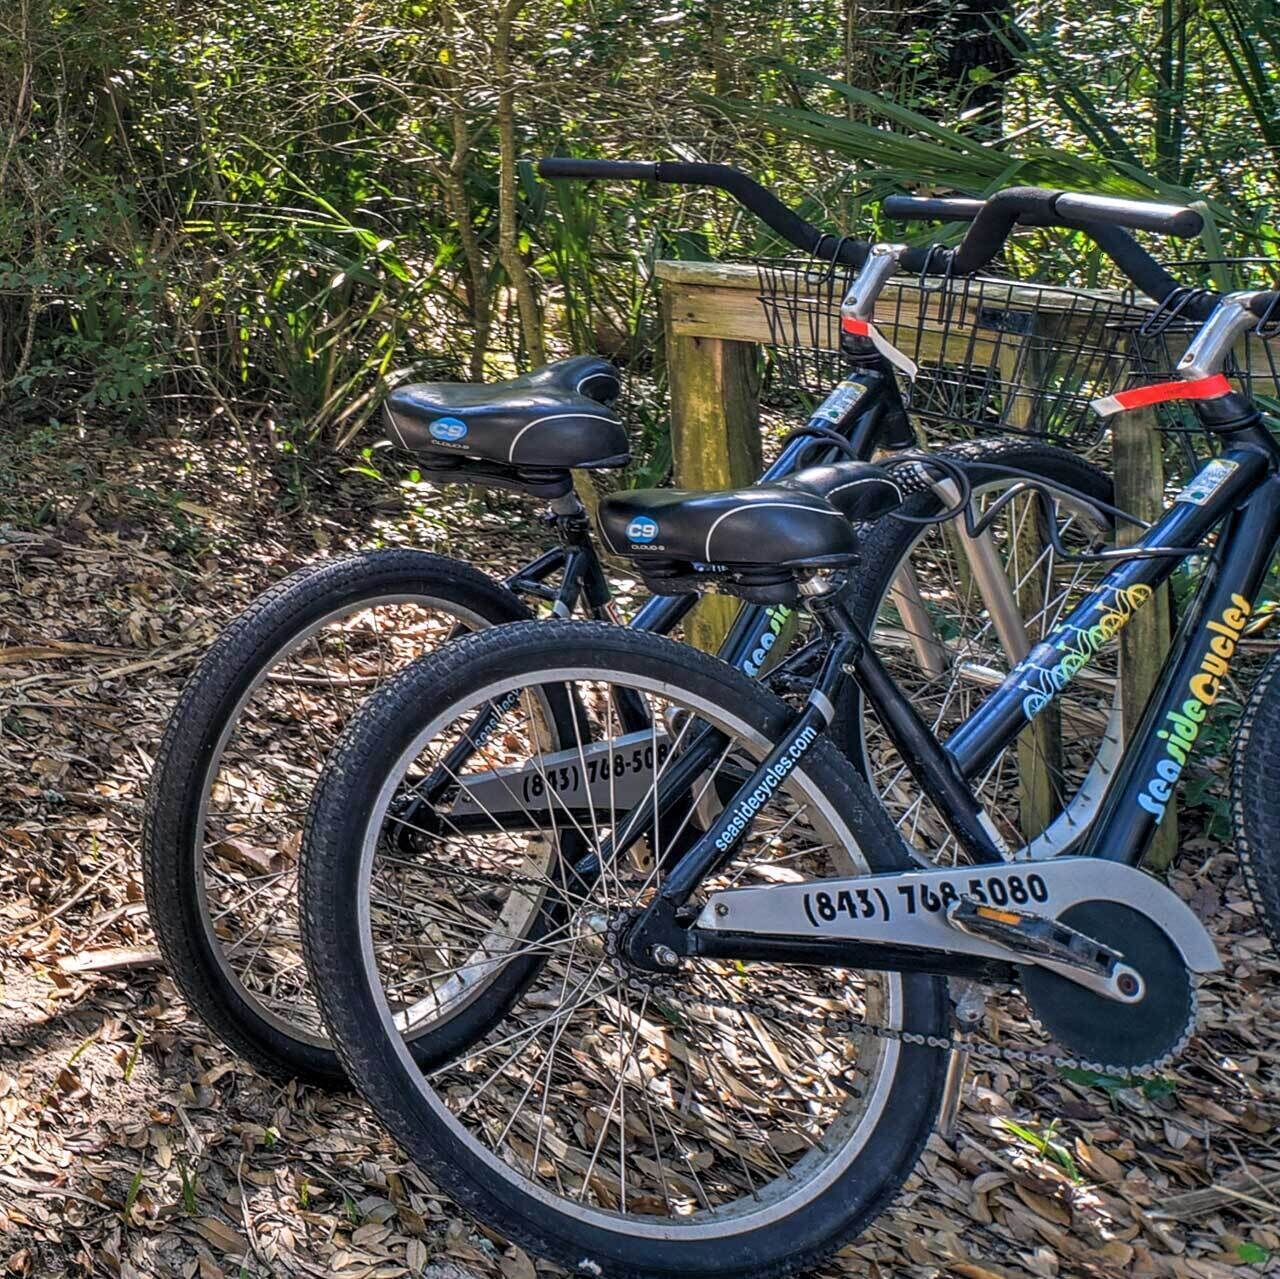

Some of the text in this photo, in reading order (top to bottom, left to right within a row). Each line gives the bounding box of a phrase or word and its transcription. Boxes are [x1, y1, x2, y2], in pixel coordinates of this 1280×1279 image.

[431, 423, 463, 437] C9
[628, 523, 656, 537] C9
[715, 725, 817, 852] seasidecycles.com
[803, 888, 890, 927] (843)
